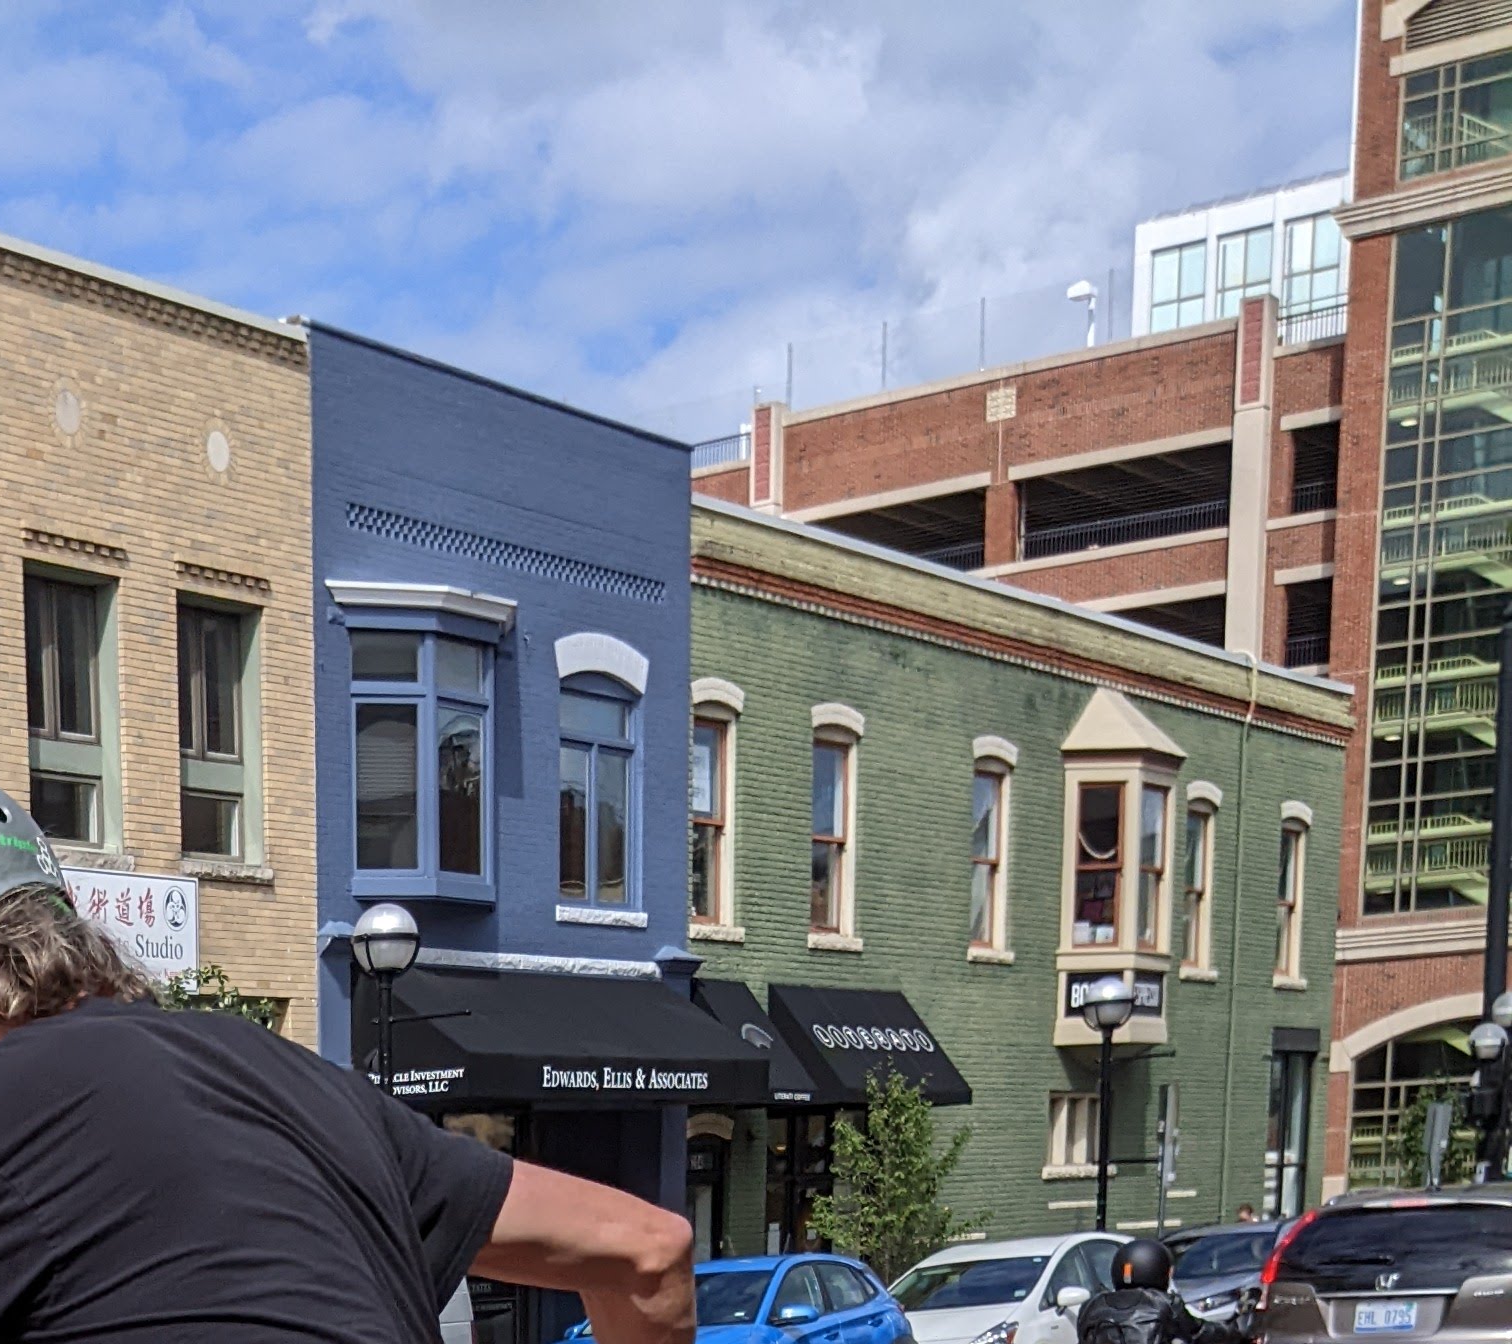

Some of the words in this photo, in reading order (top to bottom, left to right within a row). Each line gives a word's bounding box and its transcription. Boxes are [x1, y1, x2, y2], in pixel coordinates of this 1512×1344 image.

[136, 934, 183, 959] Studio
[814, 1025, 933, 1051] LITERATI
[428, 1080, 448, 1092] LLC
[542, 1066, 600, 1090] EDWARDS,
[603, 1068, 632, 1089] ELLIS
[636, 1068, 646, 1089] &
[648, 1069, 708, 1089] ASSOCIATES
